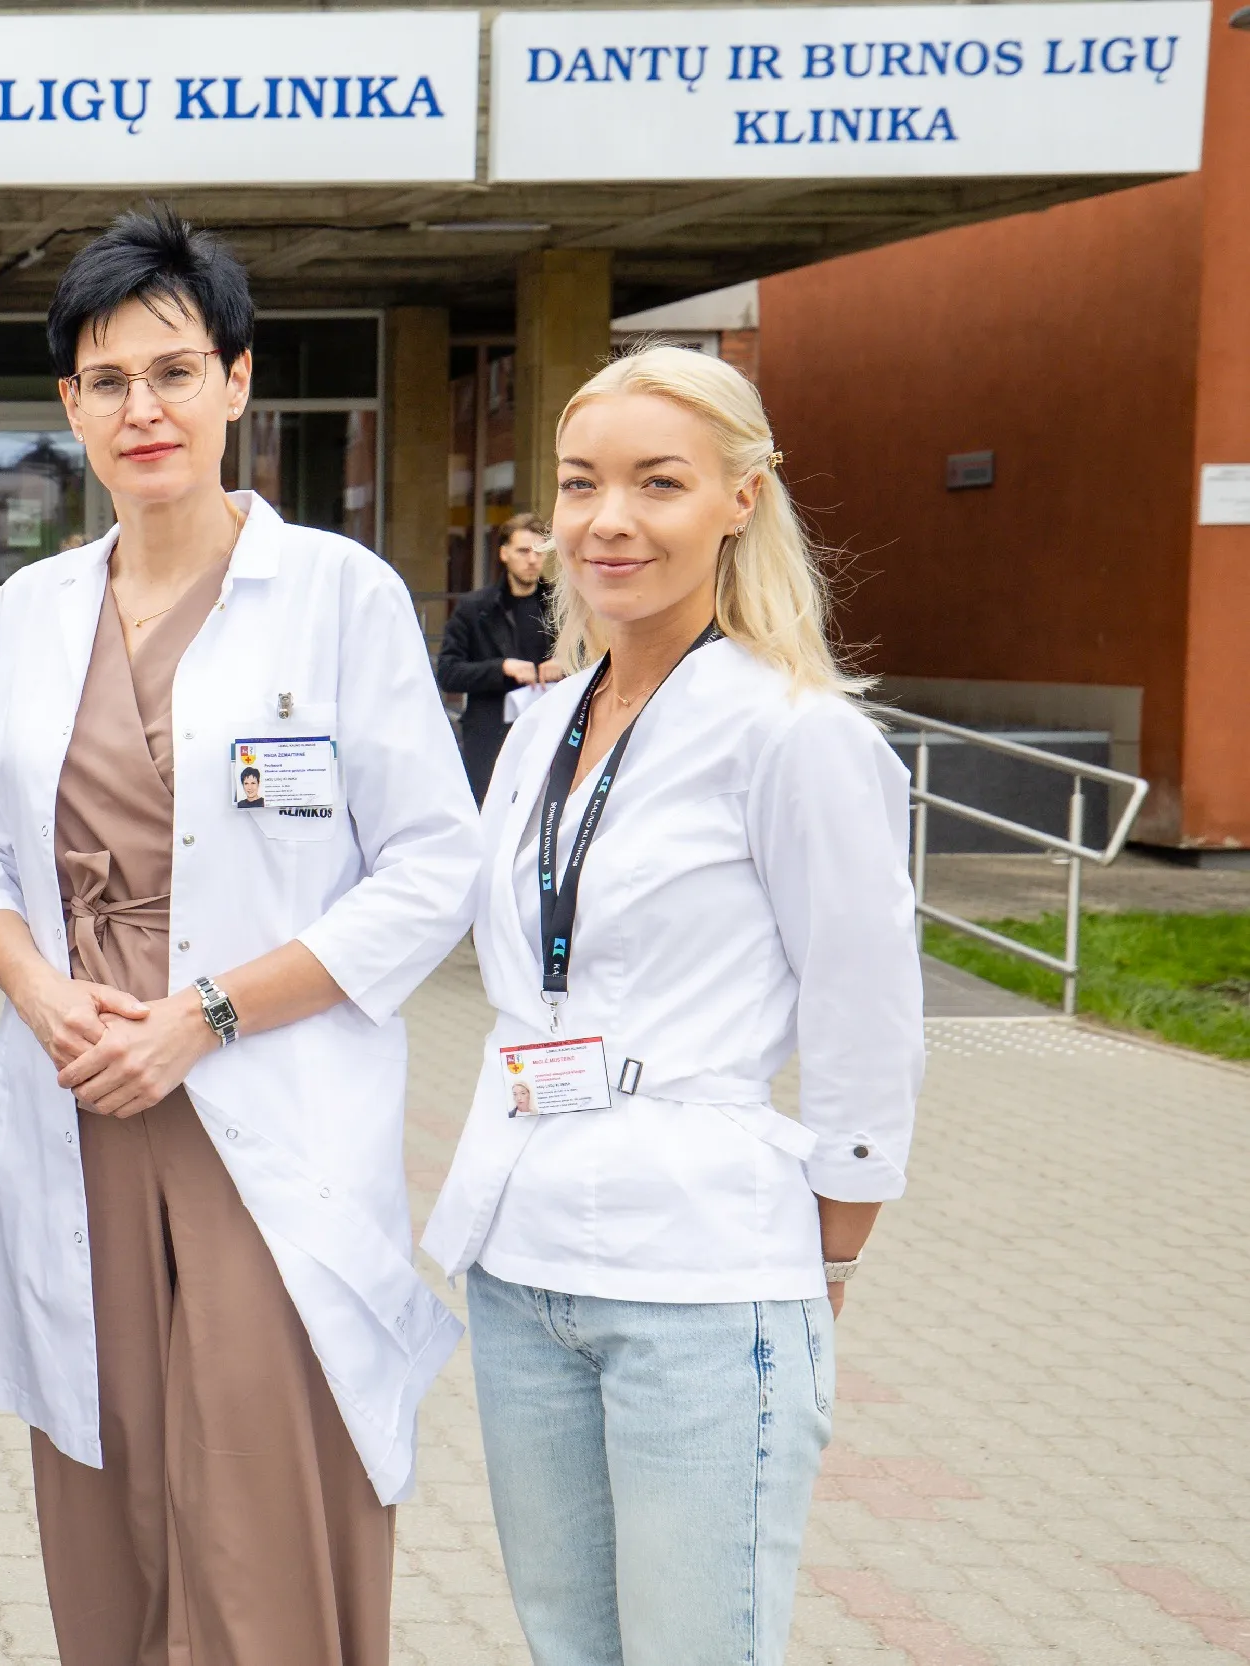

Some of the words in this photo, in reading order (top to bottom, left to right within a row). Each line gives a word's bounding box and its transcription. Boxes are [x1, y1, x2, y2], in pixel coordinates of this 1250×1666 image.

[527, 45, 708, 93] DANTŲ
[728, 45, 782, 81] IR
[801, 40, 1024, 80] BURNOS
[1043, 35, 1180, 84] LIGŲ
[174, 75, 445, 121] KLINIKA
[733, 107, 959, 146] KLINIKA
[544, 801, 558, 836] KLINIKOS
[585, 799, 601, 828] KAUNO
[543, 836, 551, 865] KAUNO
[572, 829, 590, 867] KLINIKOS
